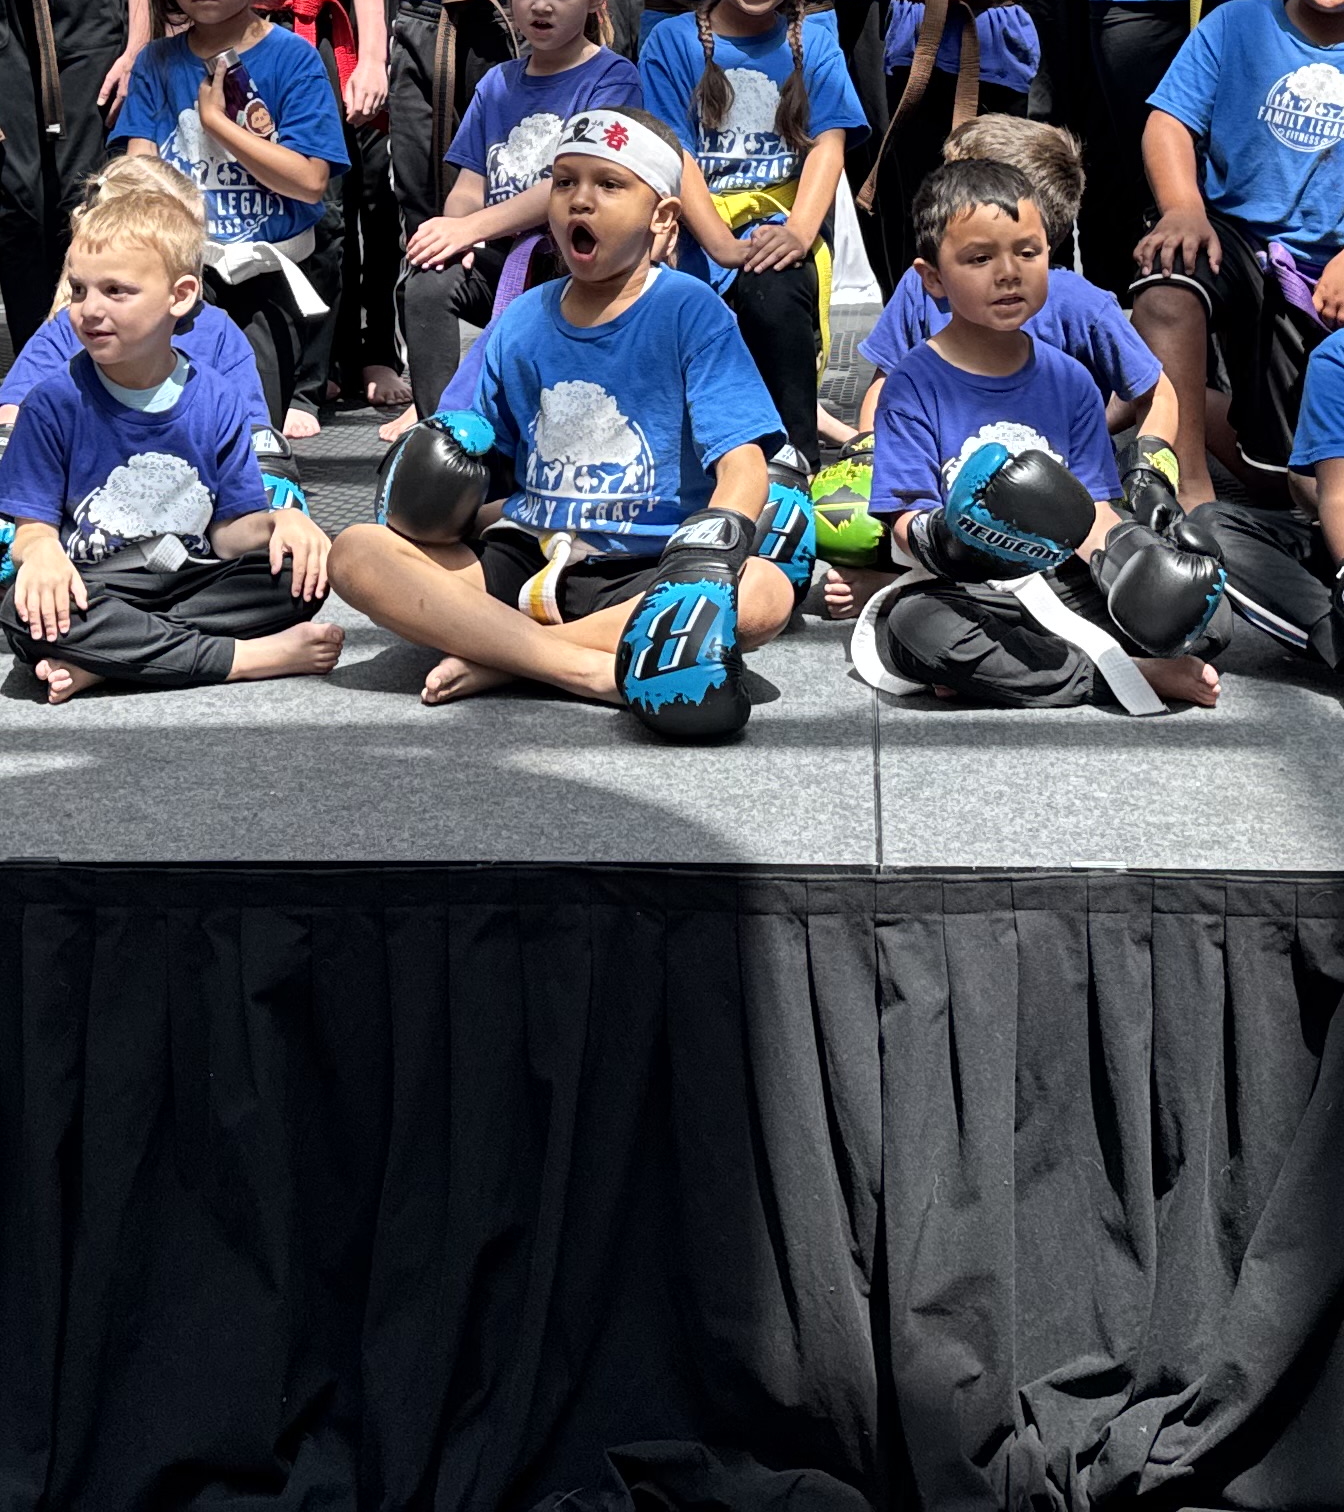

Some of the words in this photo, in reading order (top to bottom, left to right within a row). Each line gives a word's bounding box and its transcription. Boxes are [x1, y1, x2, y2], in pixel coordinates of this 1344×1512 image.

[1257, 105, 1306, 130] FAMILY
[1285, 129, 1321, 146] FITNESS
[208, 217, 242, 234] NESS
